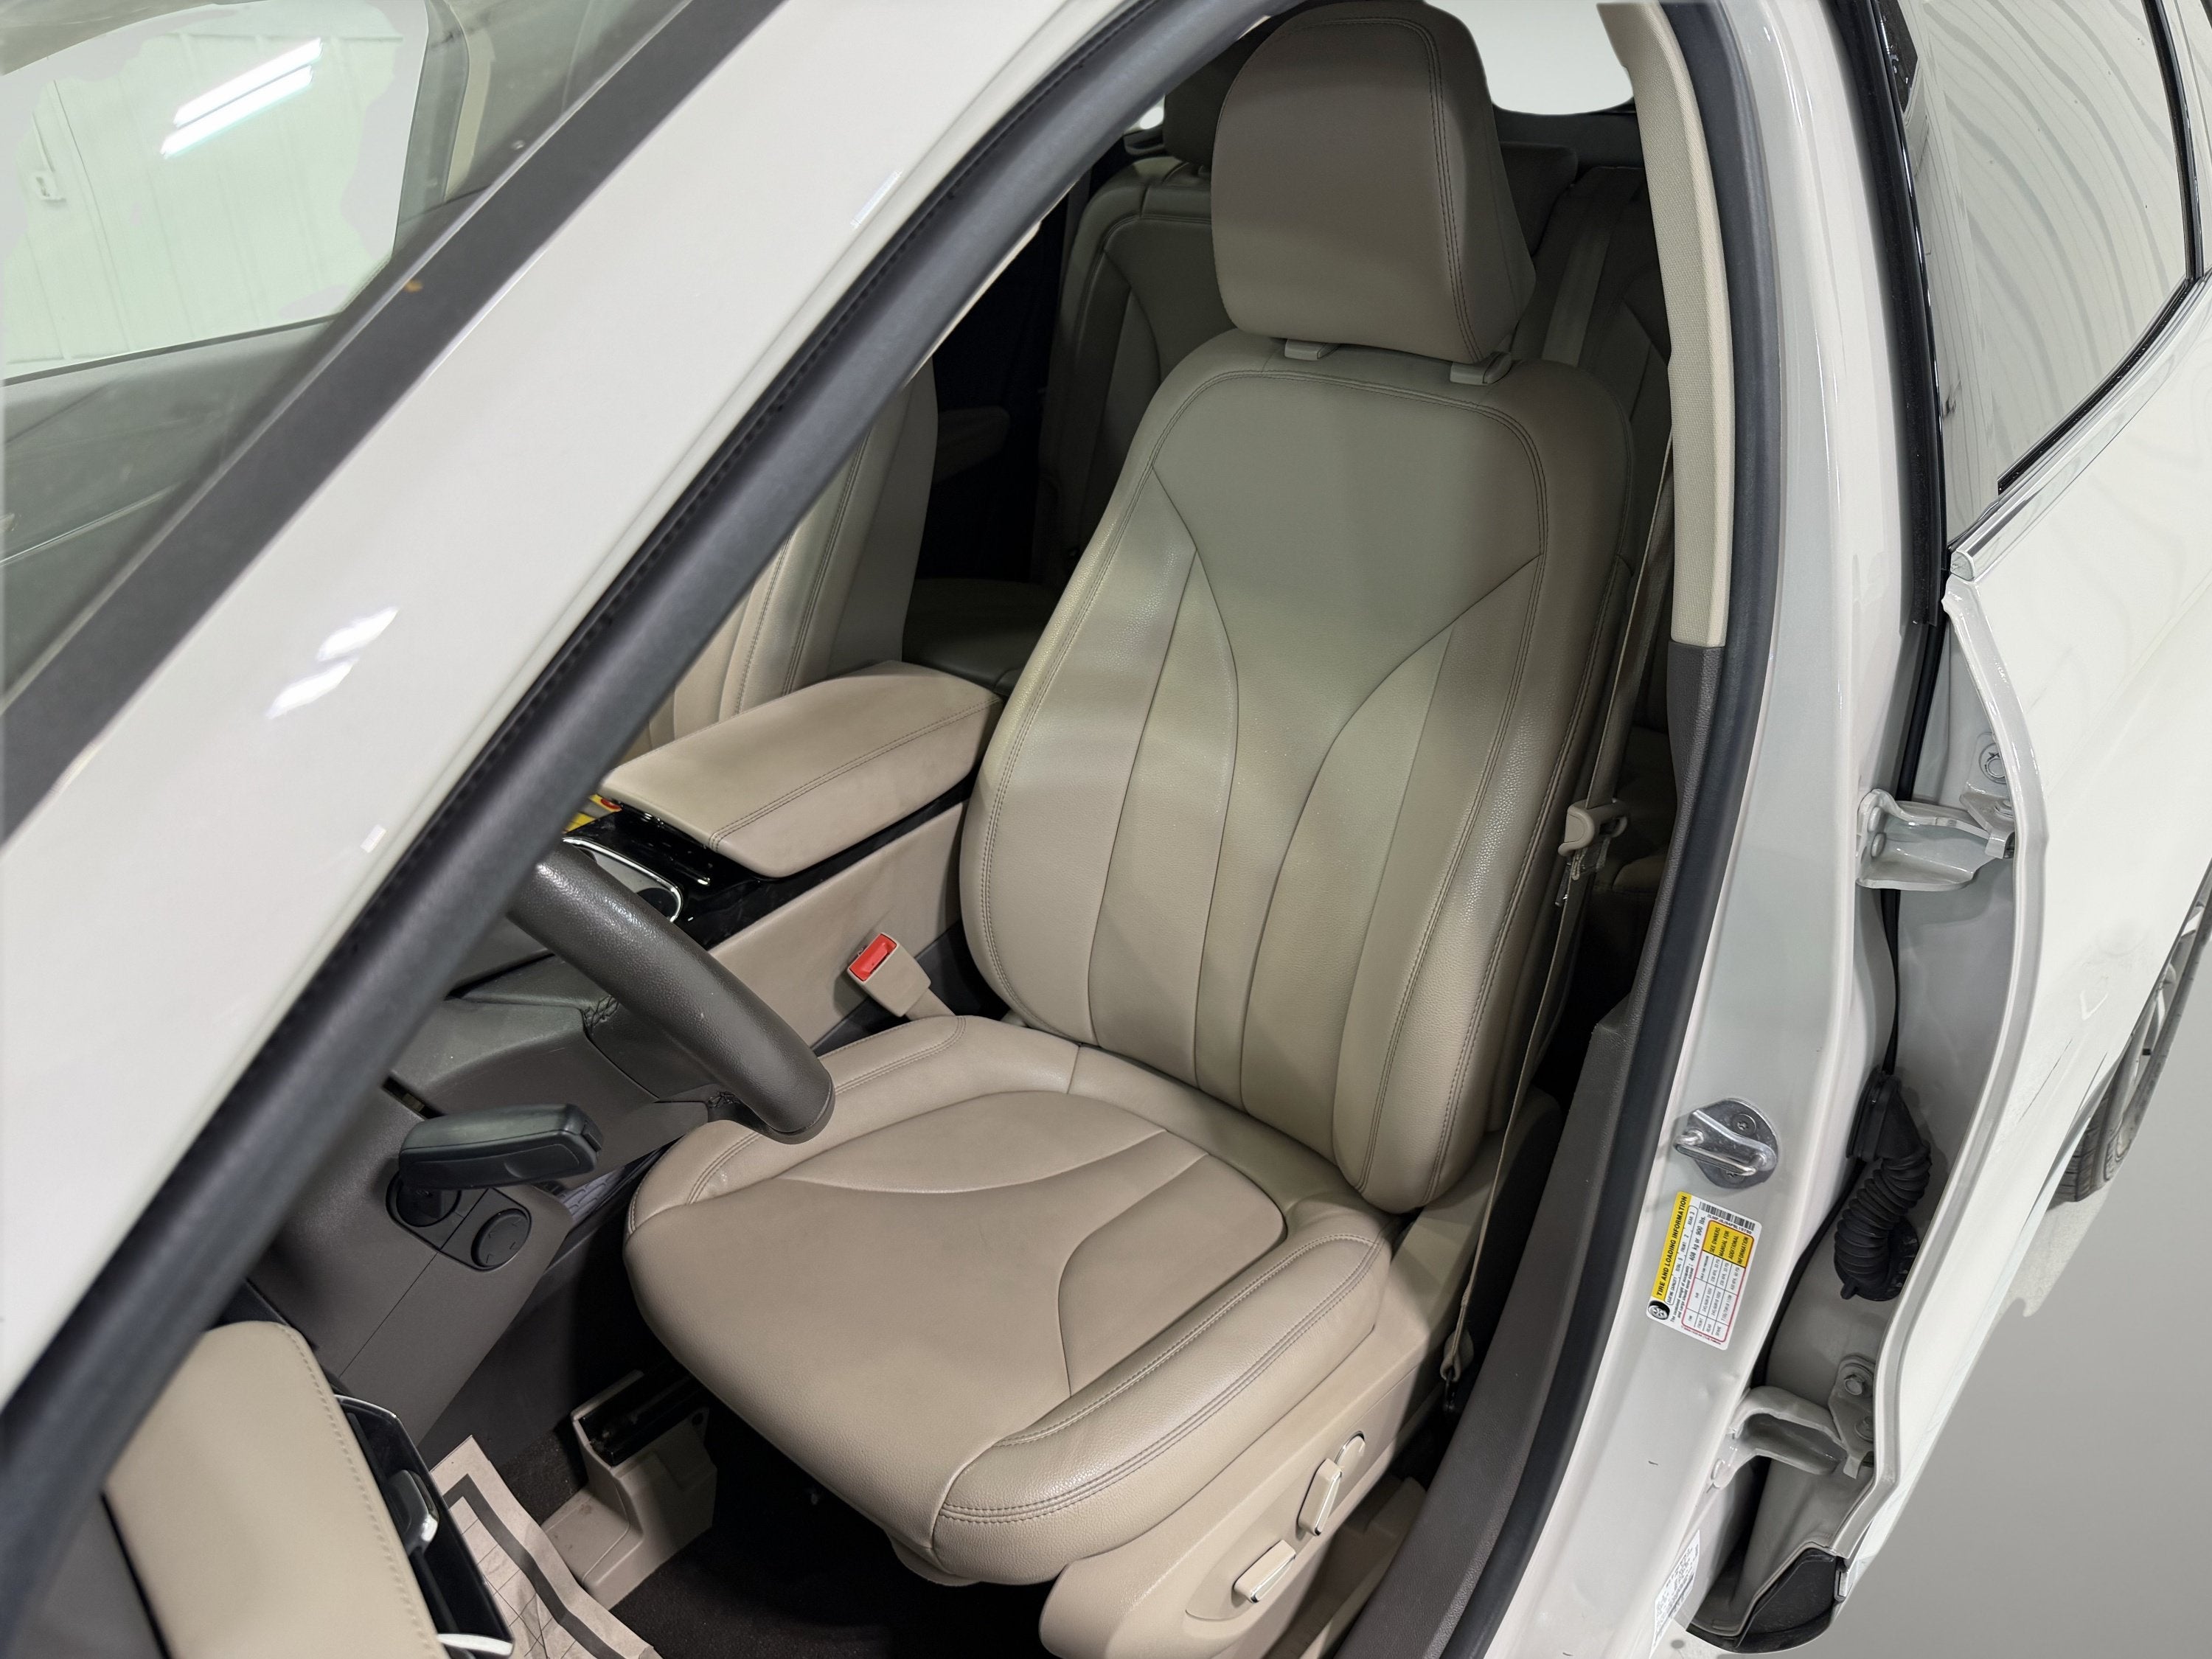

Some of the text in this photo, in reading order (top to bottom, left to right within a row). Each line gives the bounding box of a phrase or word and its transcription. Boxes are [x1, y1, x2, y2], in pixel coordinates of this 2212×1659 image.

[1695, 1225, 1703, 1236] 900
[1717, 1229, 1730, 1257] MANUAL FOR
[1656, 1195, 1688, 1296] TIRE AND LOADING INFORMATION
[1688, 1251, 1697, 1262] 408
[1691, 1242, 1700, 1251] kg
[1727, 1234, 1739, 1259] ADDITIONAL
[1736, 1235, 1749, 1265] INFORMATION
